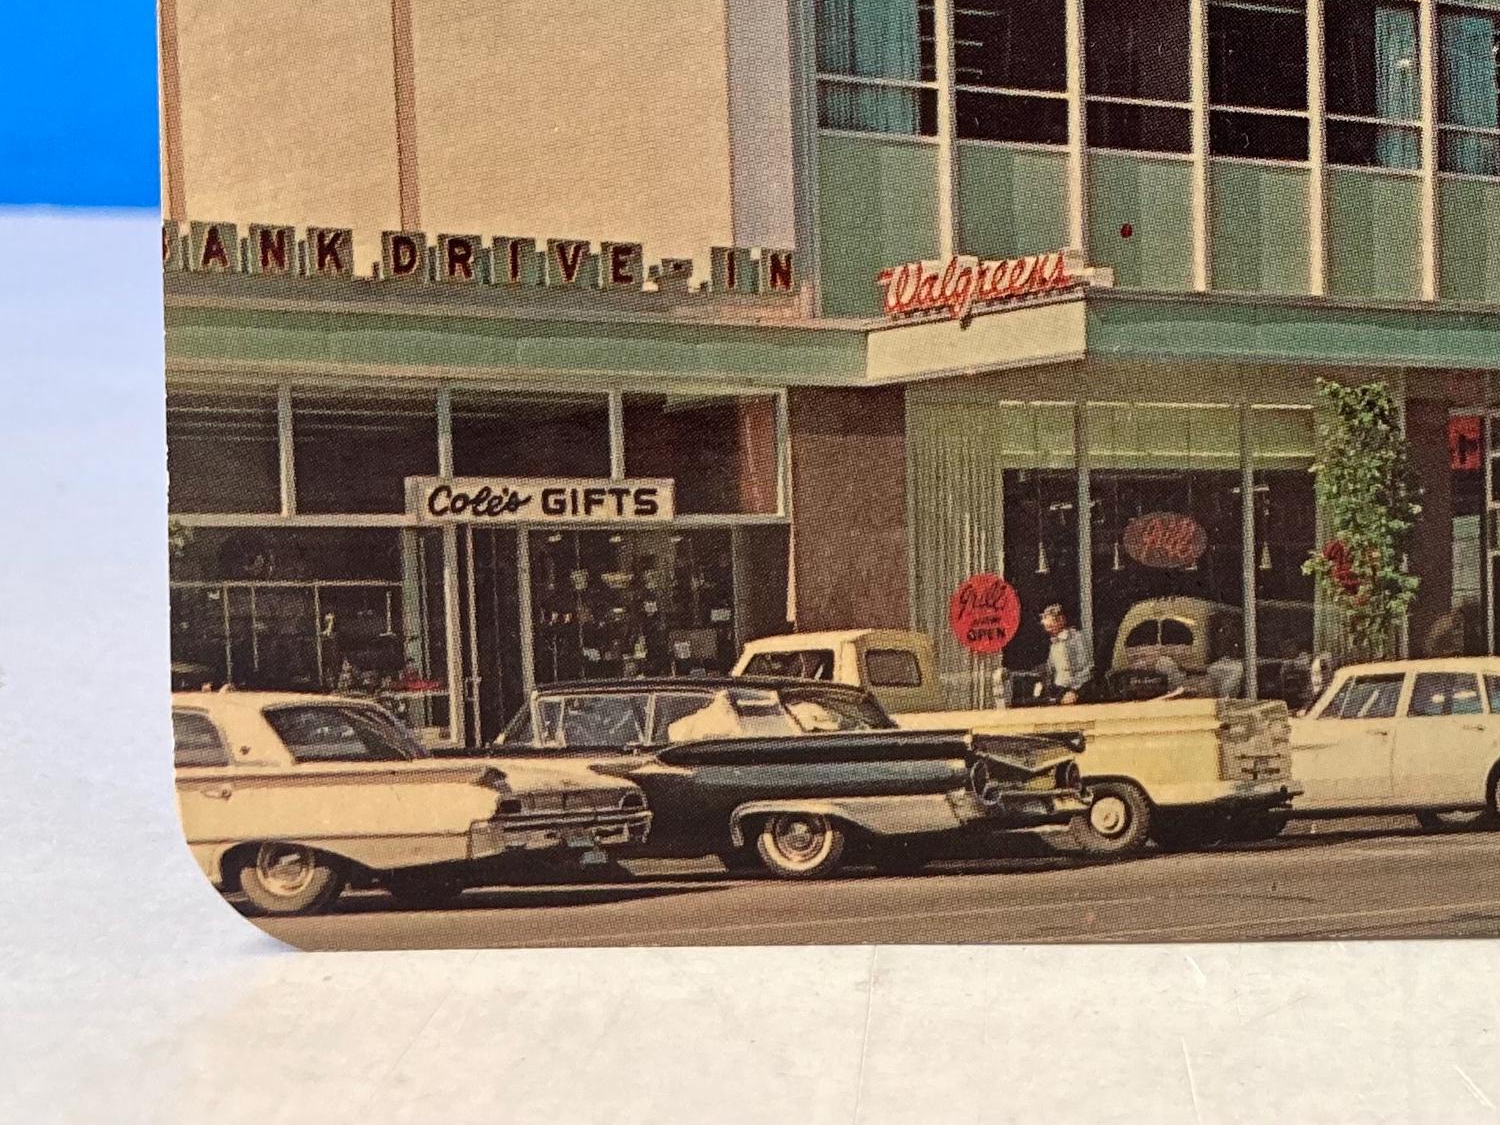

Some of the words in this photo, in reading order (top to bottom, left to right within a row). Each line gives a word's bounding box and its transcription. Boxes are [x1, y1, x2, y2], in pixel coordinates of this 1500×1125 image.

[163, 224, 344, 271] ANK
[877, 249, 1078, 320] Walgreens
[427, 484, 532, 517] Cole's
[540, 487, 660, 516] GIFTS
[966, 626, 1006, 642] OPEN
